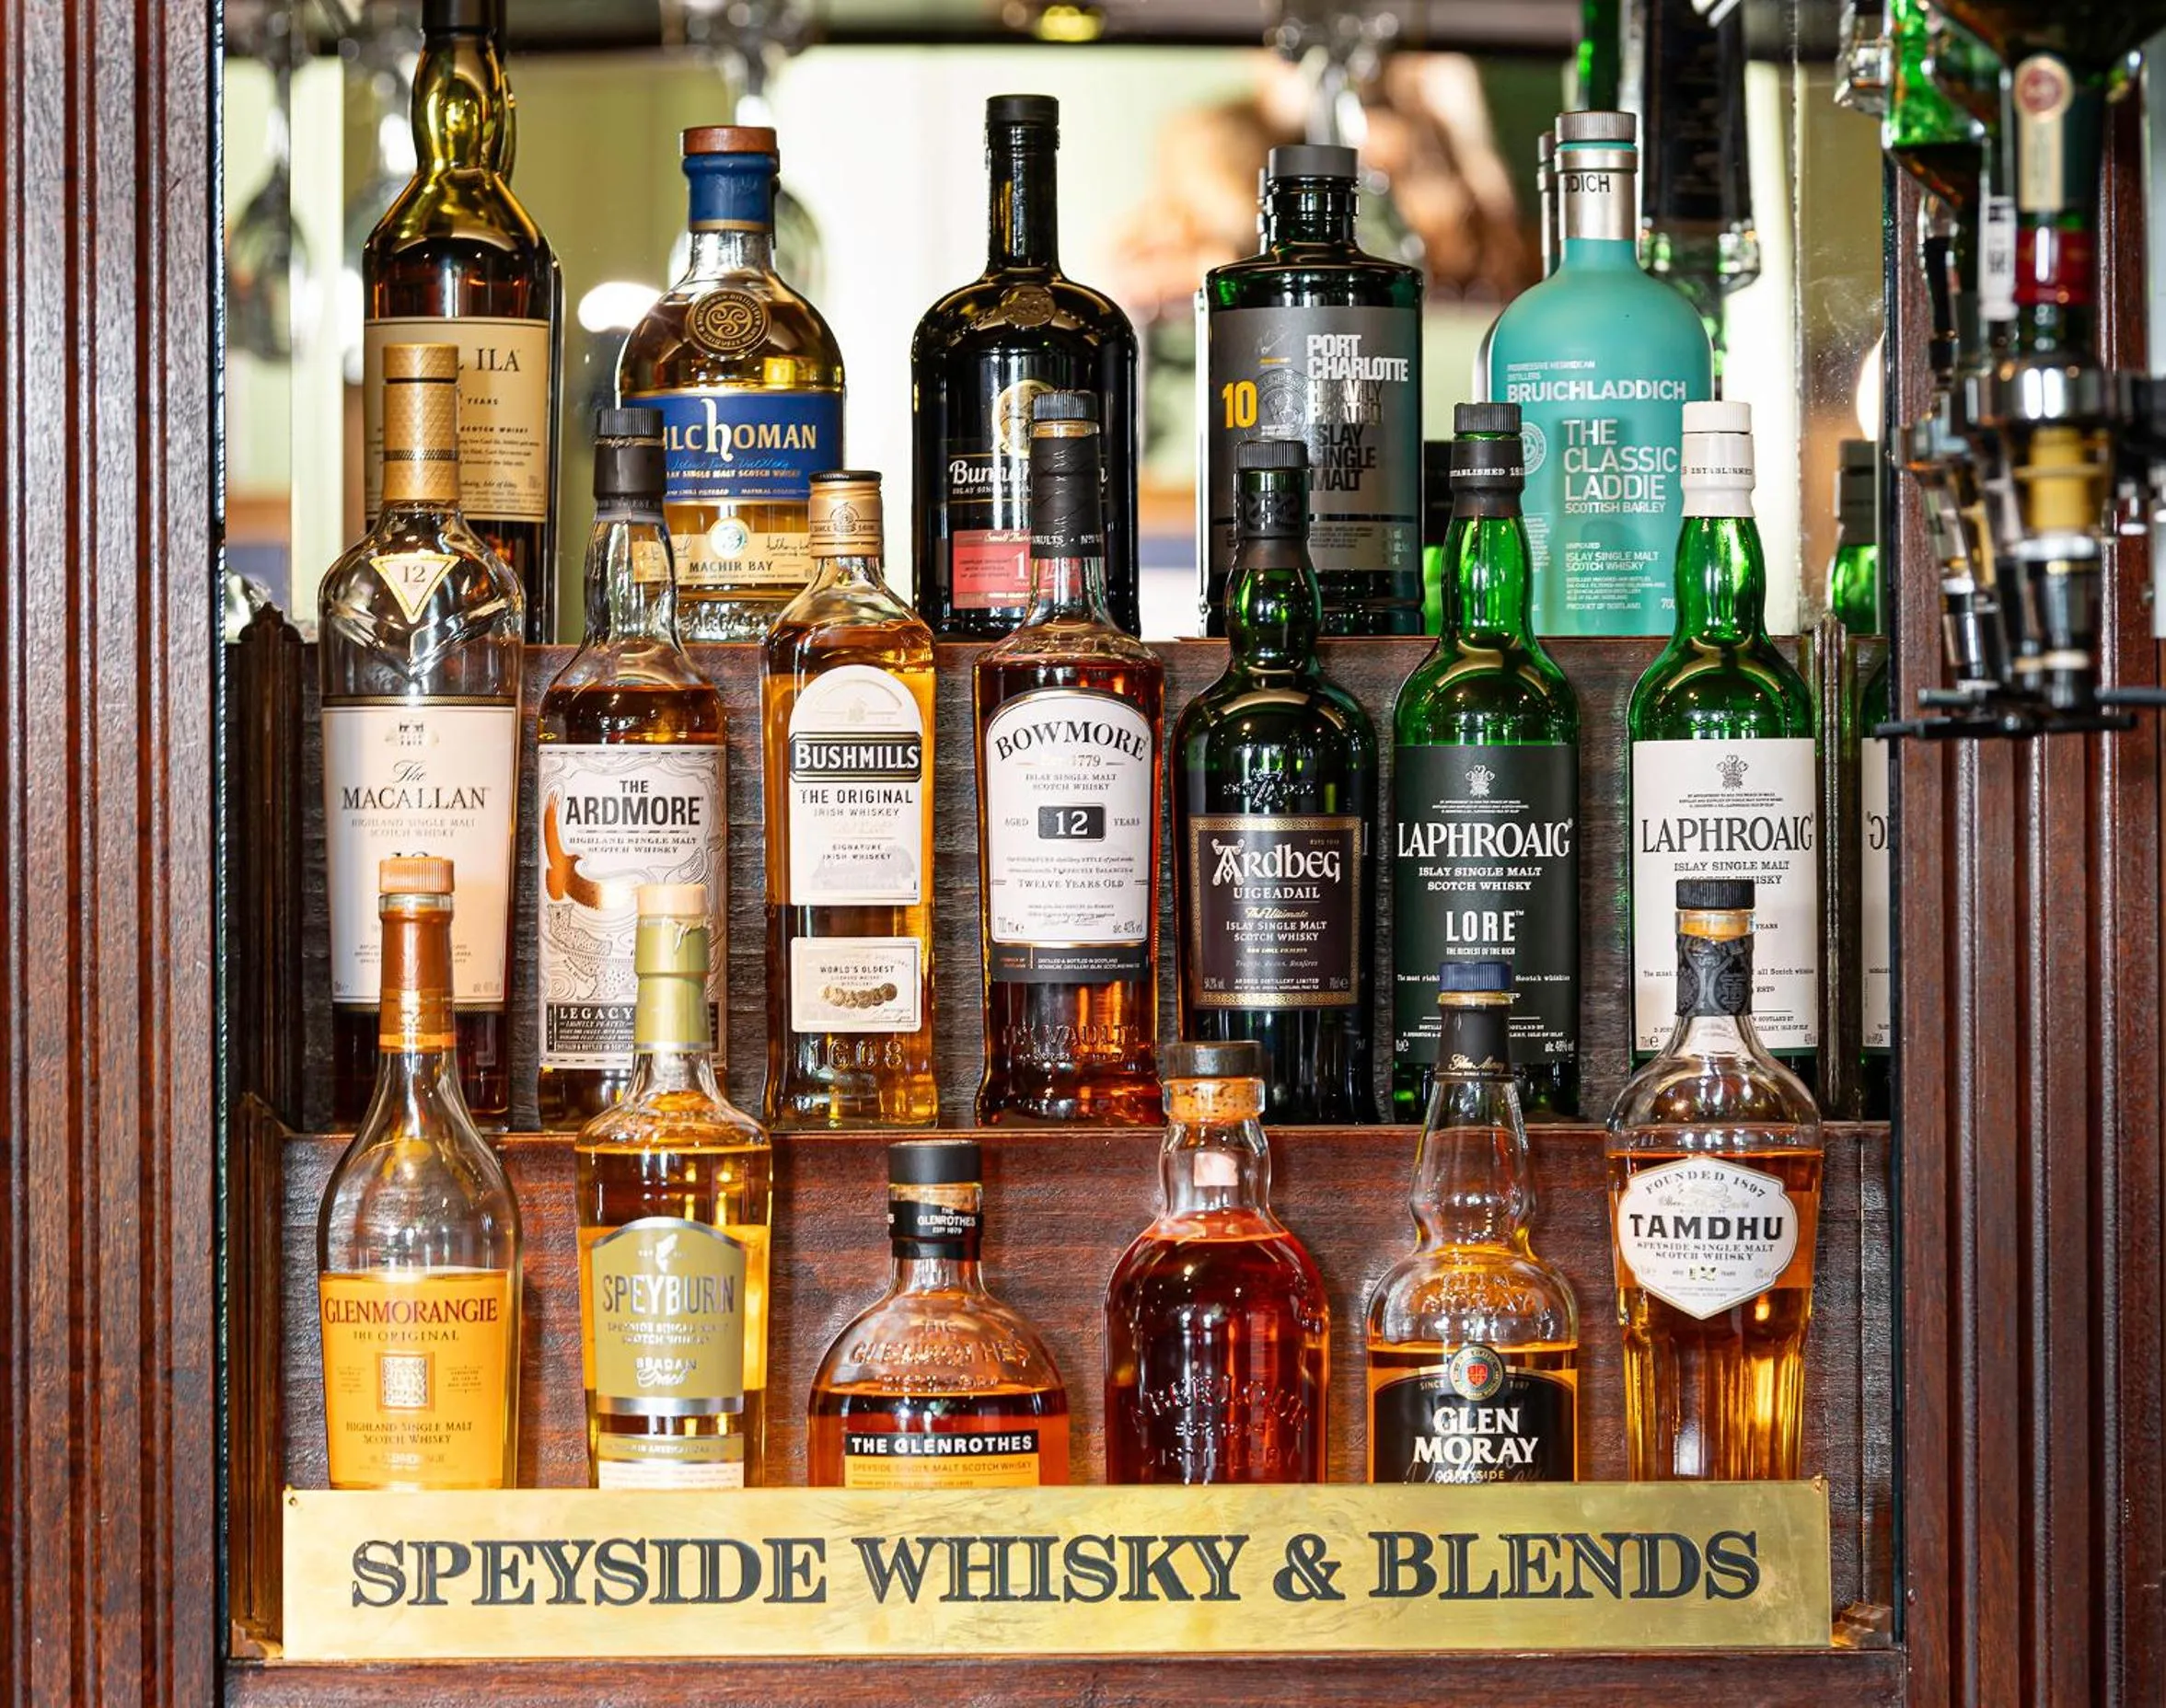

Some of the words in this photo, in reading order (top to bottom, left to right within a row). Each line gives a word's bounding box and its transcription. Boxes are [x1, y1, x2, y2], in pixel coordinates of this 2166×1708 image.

[1307, 334, 1361, 357] PORT
[476, 348, 520, 372] ILA
[1307, 356, 1408, 382] CHARLOTTE
[1507, 379, 1686, 403] BRUICHLADDICH
[1222, 380, 1257, 428] 10
[1563, 419, 1617, 445] THE
[1564, 447, 1677, 474] CLASSIC
[1310, 469, 1363, 490] MALT
[1565, 475, 1665, 501] LADDIE
[1565, 502, 1620, 514] SCOTTISH
[1623, 502, 1665, 514] BARLEY
[690, 561, 742, 572] MACHIR
[748, 560, 773, 571] BAY
[1566, 552, 1593, 560] ISLAY
[1595, 552, 1632, 560] SINGLE
[1634, 552, 1658, 560] MALT
[1566, 562, 1604, 571] SCOTCH
[1606, 562, 1644, 571] WHISKY
[402, 565, 426, 583] 12
[995, 721, 1147, 762] BOWMORE
[795, 743, 920, 769] BUSHMILLS
[393, 760, 427, 783] The
[620, 780, 649, 792] THE
[800, 790, 828, 803] THE
[837, 790, 913, 803] ORIGINAL
[342, 787, 487, 810] MACALLAN
[565, 796, 701, 825] ARDMORE
[814, 808, 844, 816] IRISH
[850, 808, 899, 816] WHISKEY
[1056, 811, 1088, 835] 12
[1398, 822, 1570, 858] LAPHROAIG
[1642, 816, 1813, 853] LAPHROAIG
[1211, 838, 1340, 886] Ardbeg
[1419, 867, 1451, 876] ISLAY
[1454, 867, 1503, 876] SINGLE
[1507, 867, 1542, 876] MALT
[1674, 862, 1708, 871] ISLAY
[1712, 861, 1757, 871] SINGLE
[1761, 860, 1789, 870] MALT
[1019, 880, 1062, 889] TWELVE
[1065, 880, 1101, 889] YEARS
[1104, 879, 1124, 888] OLD
[1233, 887, 1320, 899] UIGEADAIL
[1428, 881, 1476, 891] SCOTCH
[1480, 881, 1532, 891] WHISKY
[1226, 921, 1252, 930] ISLAY
[1258, 920, 1296, 929] SINGLE
[1300, 920, 1327, 929] MALT
[1446, 910, 1516, 942] LORE
[1234, 933, 1273, 941] SCOTCH
[1278, 932, 1319, 941] WHISKY
[820, 965, 858, 974] WORLD'S
[862, 965, 895, 974] OLDEST
[560, 1007, 633, 1020] LEGACY
[1646, 1171, 1725, 1194] FOUNDED
[1629, 1214, 1784, 1241] TAMDHU
[1638, 1242, 1690, 1252] SPEYSIDE
[1694, 1243, 1741, 1252] SINGLE
[1743, 1243, 1775, 1252] MALT
[1656, 1252, 1698, 1260] SCOTCH
[1703, 1252, 1754, 1261] WHISKY
[603, 1274, 736, 1316] SPEYBURN
[324, 1297, 497, 1324] GLENMORANGIE
[378, 1330, 459, 1342] ORIGINAL
[346, 1421, 397, 1432] HIGHLAND
[446, 1422, 472, 1431] MALT
[1432, 1407, 1519, 1435] GLEN
[364, 1435, 404, 1444] SCOTCH
[410, 1434, 451, 1444] WHISKY
[851, 1437, 887, 1453] THE
[894, 1436, 1032, 1453] GLENROTHES
[1414, 1436, 1538, 1465] MORAY
[932, 1463, 958, 1471] MALT
[962, 1462, 999, 1471] SCOTCH
[352, 1537, 827, 1608] SPEYSIDE
[851, 1534, 1249, 1604] WHISKY
[1273, 1530, 1346, 1601] &
[1368, 1529, 1760, 1601] BLENDS
